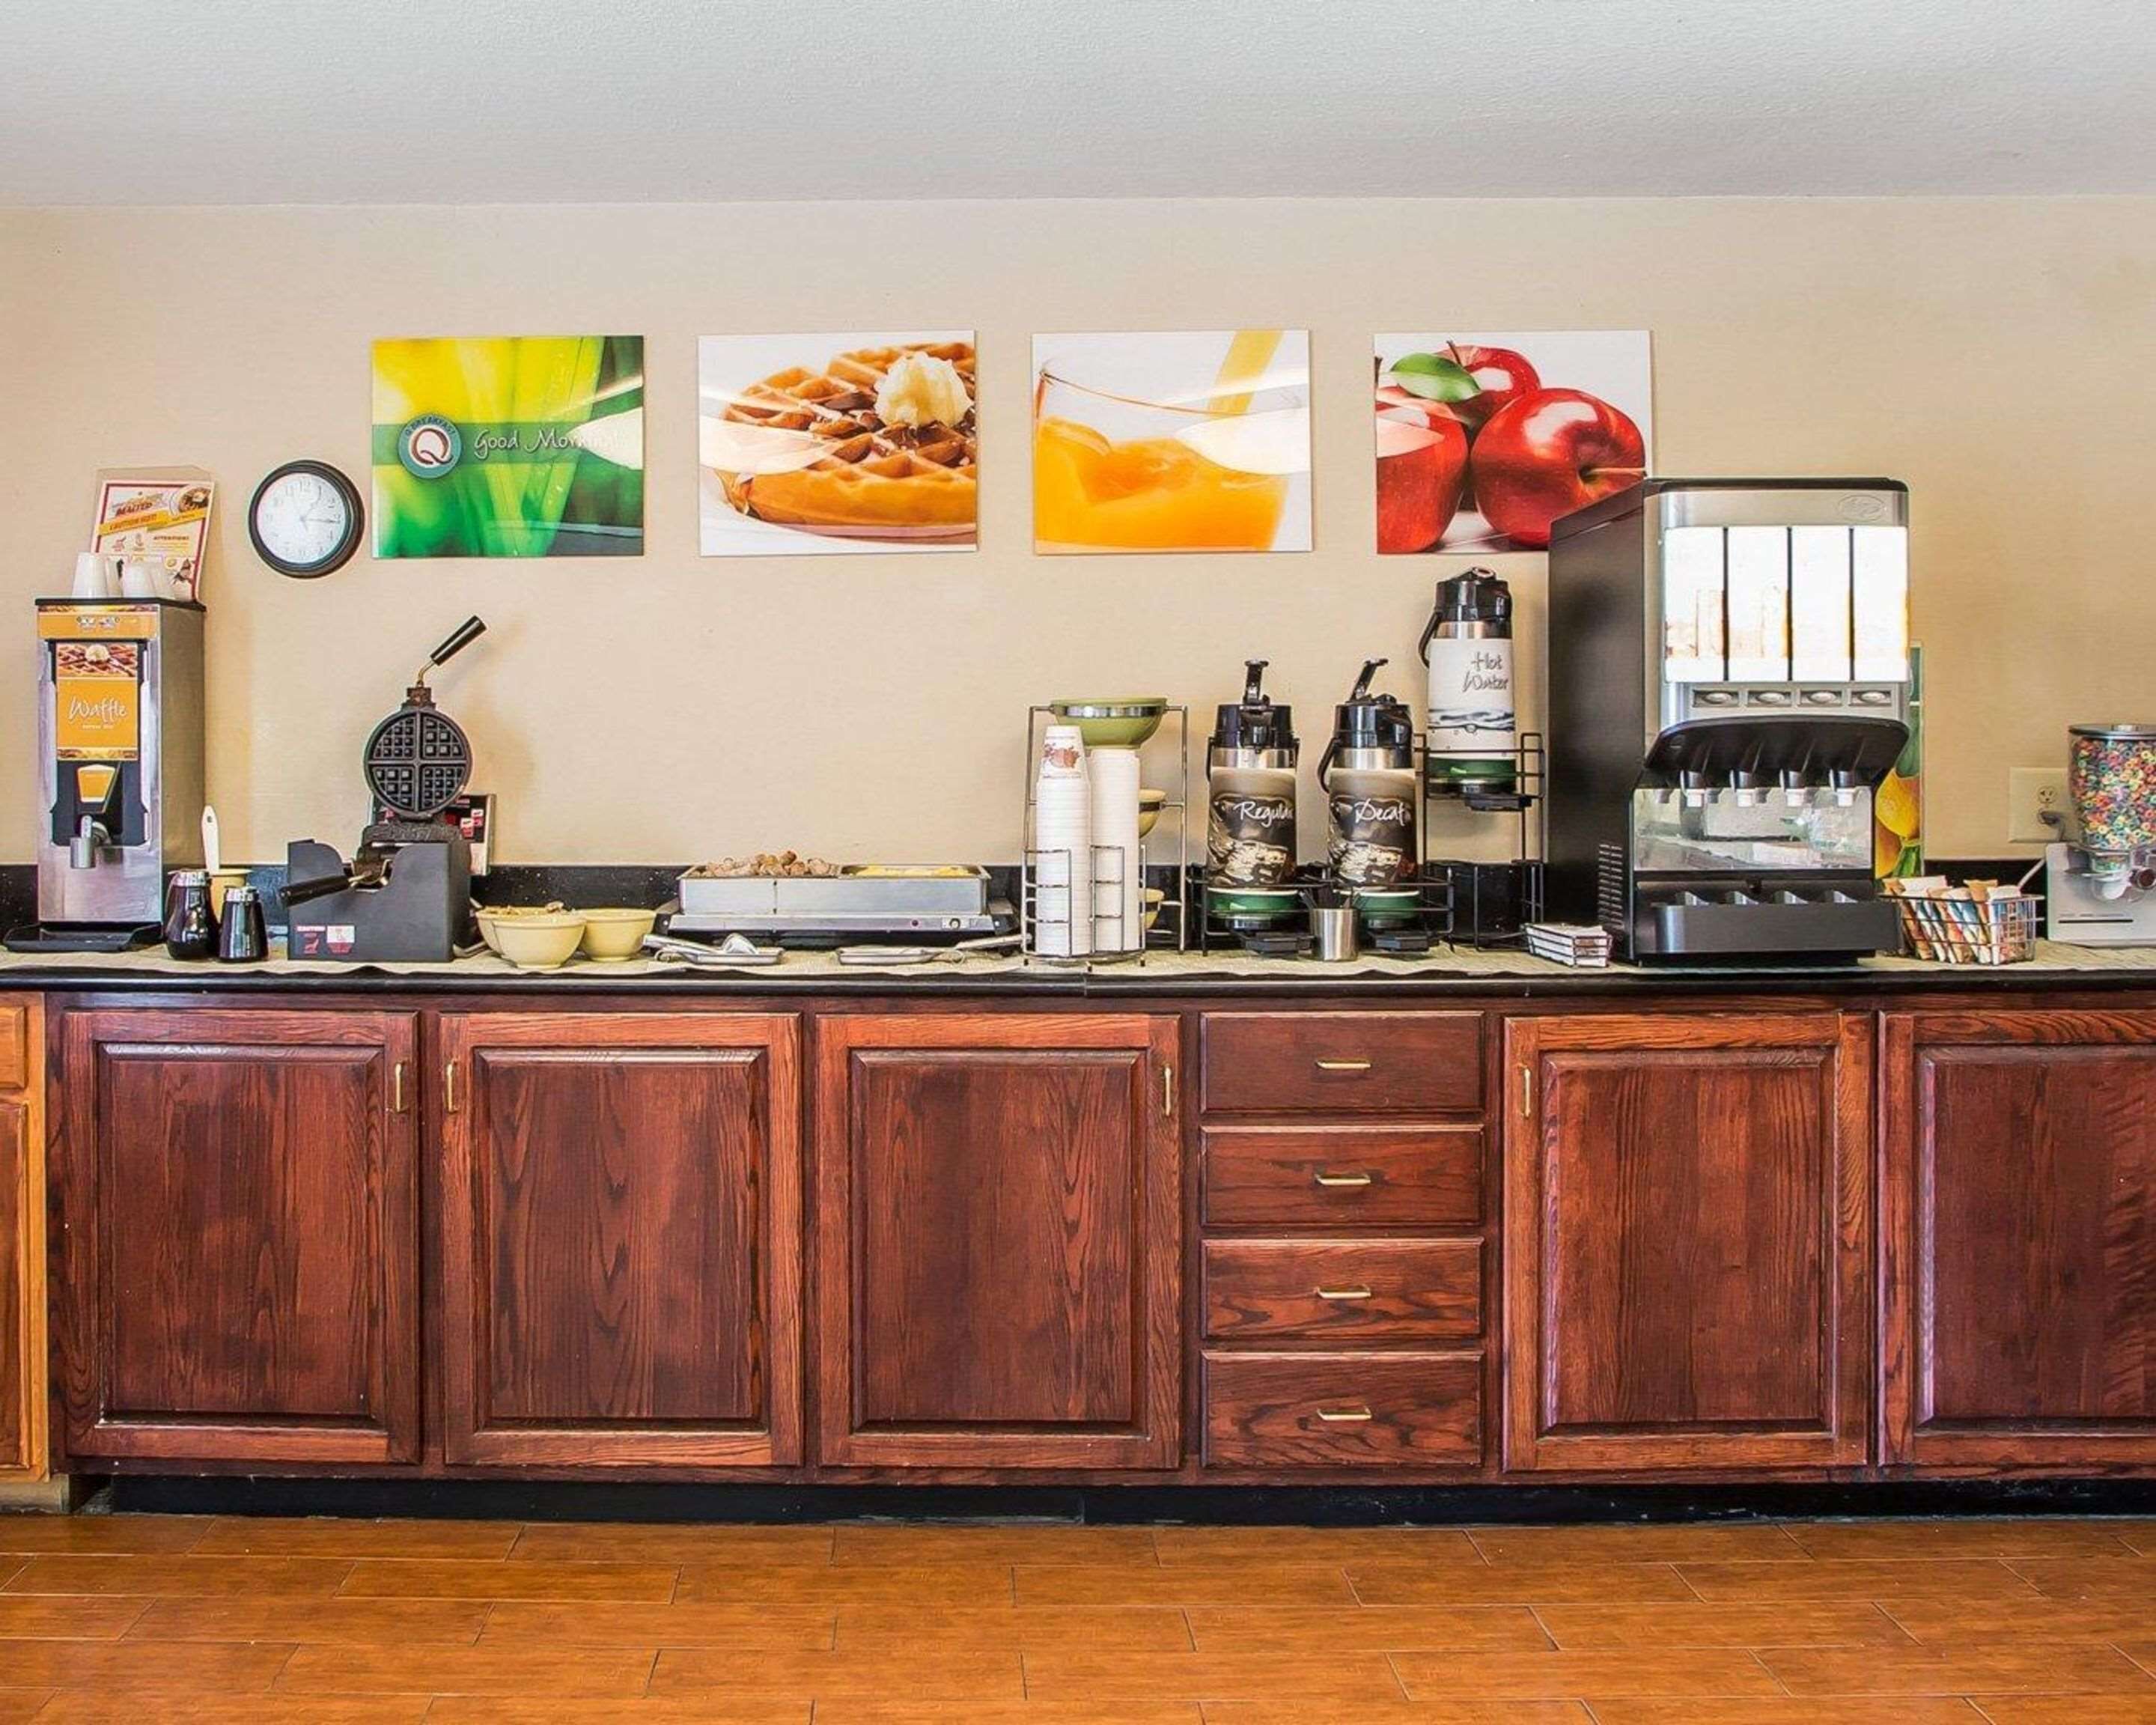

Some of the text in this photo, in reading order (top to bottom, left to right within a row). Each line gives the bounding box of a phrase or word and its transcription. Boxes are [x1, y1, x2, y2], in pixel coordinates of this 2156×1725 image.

[411, 428, 454, 465] Q
[474, 430, 518, 459] Good
[1470, 651, 1502, 672] Hot
[1462, 671, 1509, 693] Water
[68, 696, 127, 725] Waffle
[1354, 798, 1406, 827] Decaf
